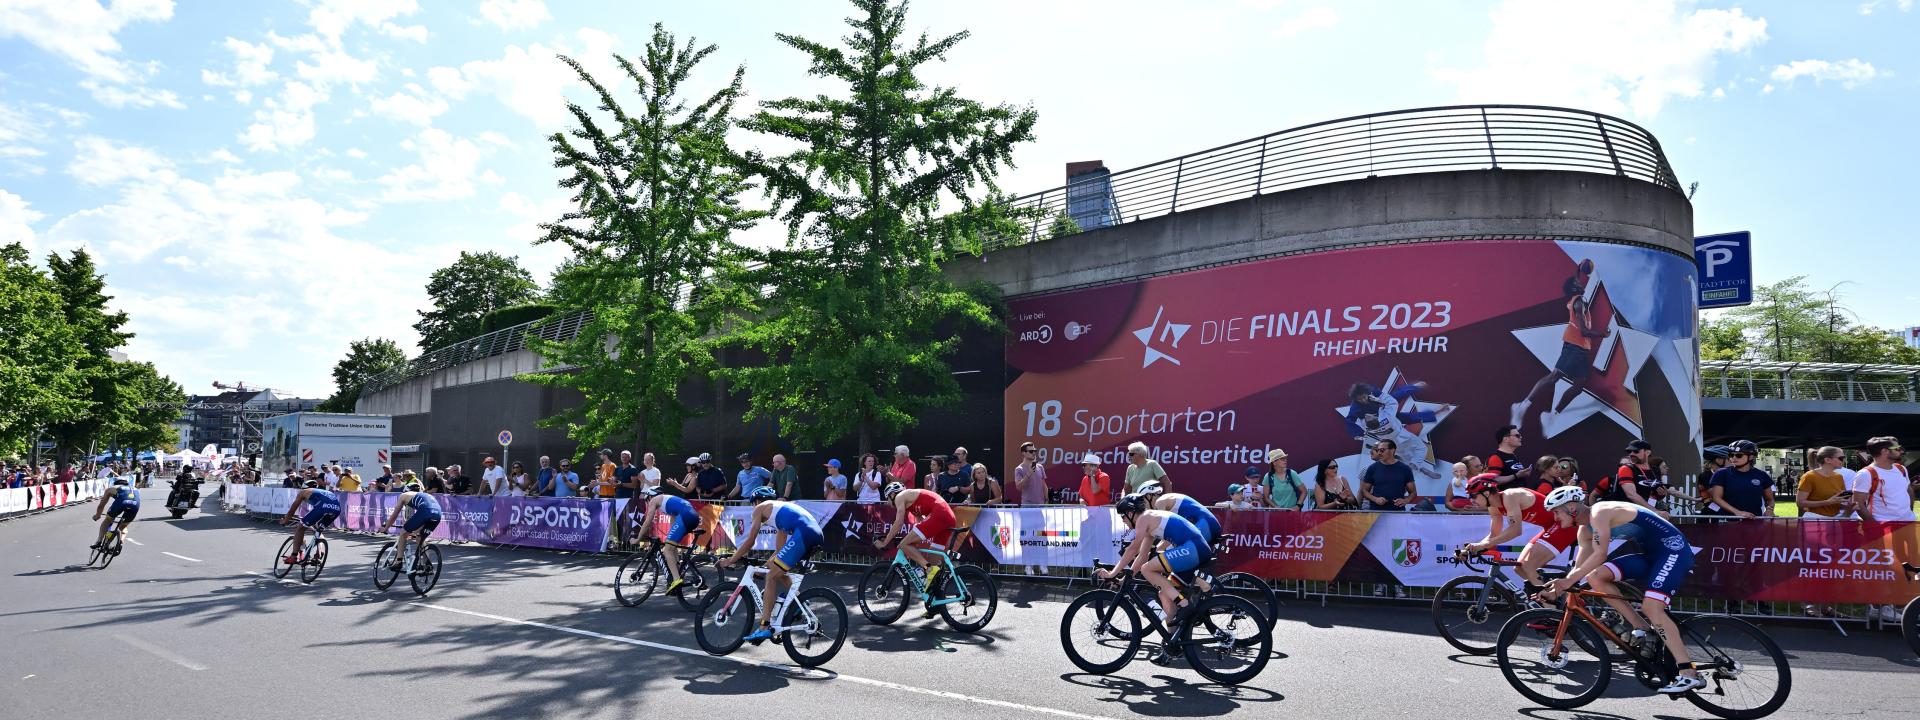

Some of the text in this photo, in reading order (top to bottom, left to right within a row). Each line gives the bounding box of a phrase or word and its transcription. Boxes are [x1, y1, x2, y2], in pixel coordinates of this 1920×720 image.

[1706, 248, 1732, 277] P
[1699, 280, 1745, 288] TADTTOR
[1704, 290, 1736, 299] EINFAHRT
[1034, 312, 1046, 320] bei:
[1200, 301, 1452, 344] DIE FINALS 2023
[1313, 336, 1449, 356] RHEIN-RUHR
[1022, 400, 1236, 442] 18 Sportarten
[1038, 447, 1048, 464] 9
[1146, 444, 1271, 464] Meistertitel
[510, 506, 592, 529] D.SPORTS
[511, 527, 589, 544] Sportstadt Düsseldorf
[866, 522, 881, 534] DIE
[777, 540, 796, 558] HYLO
[1019, 540, 1078, 548] SPORTLAND.NRW
[1226, 534, 1282, 548] FINALS
[1285, 535, 1324, 549] 2023
[1166, 548, 1190, 560] HYLO
[1258, 551, 1323, 561] RHEIN-RUHR
[1711, 547, 1895, 566] DIE FINALS 2023
[1799, 568, 1896, 580] RHEIN-RUHR
